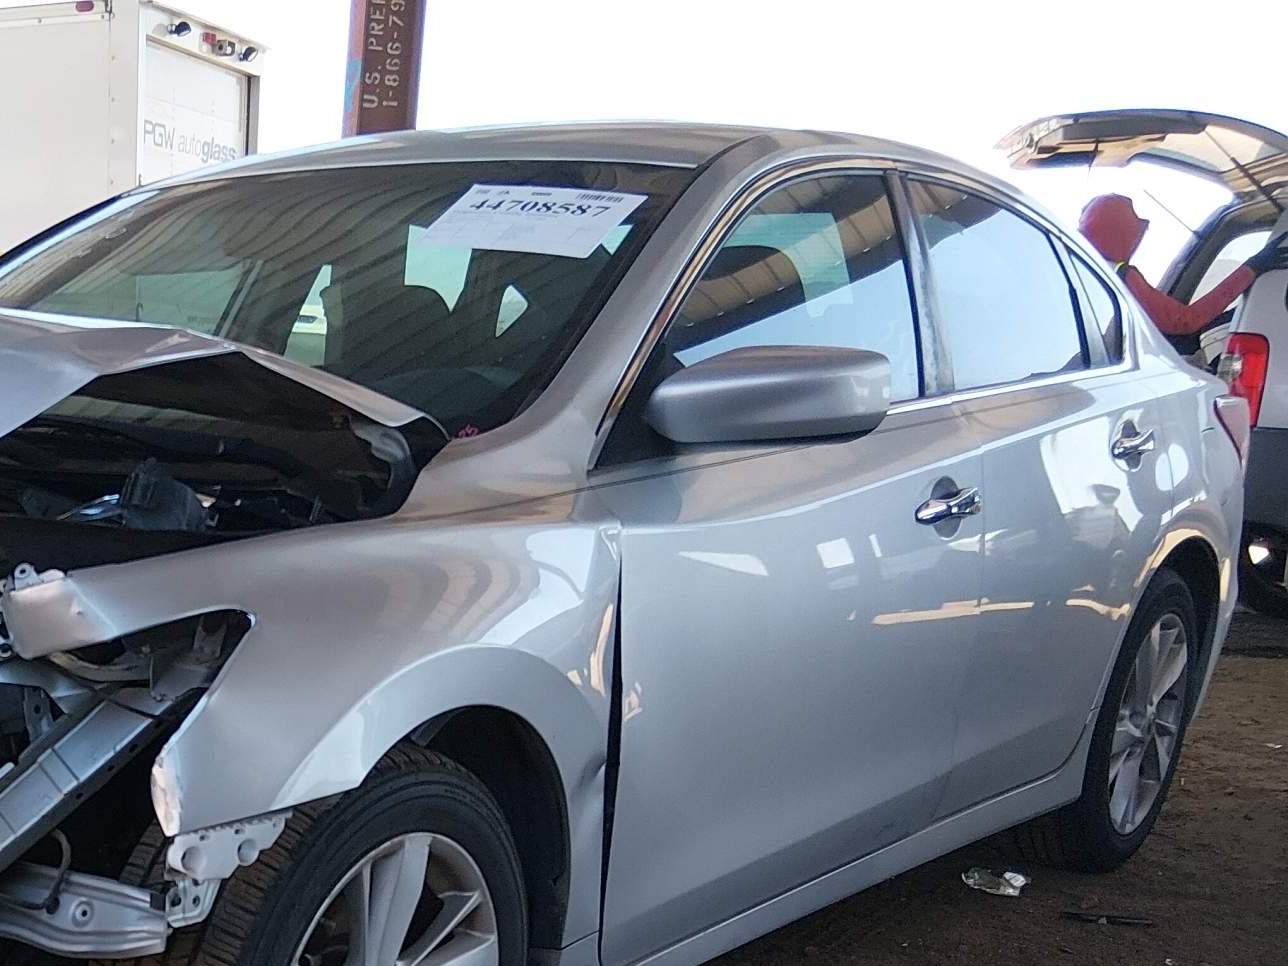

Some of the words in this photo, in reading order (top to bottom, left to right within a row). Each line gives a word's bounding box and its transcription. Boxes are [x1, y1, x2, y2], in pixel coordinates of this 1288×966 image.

[143, 119, 176, 151] PGW
[177, 132, 237, 163] autoglass
[469, 198, 611, 218] 44708587
